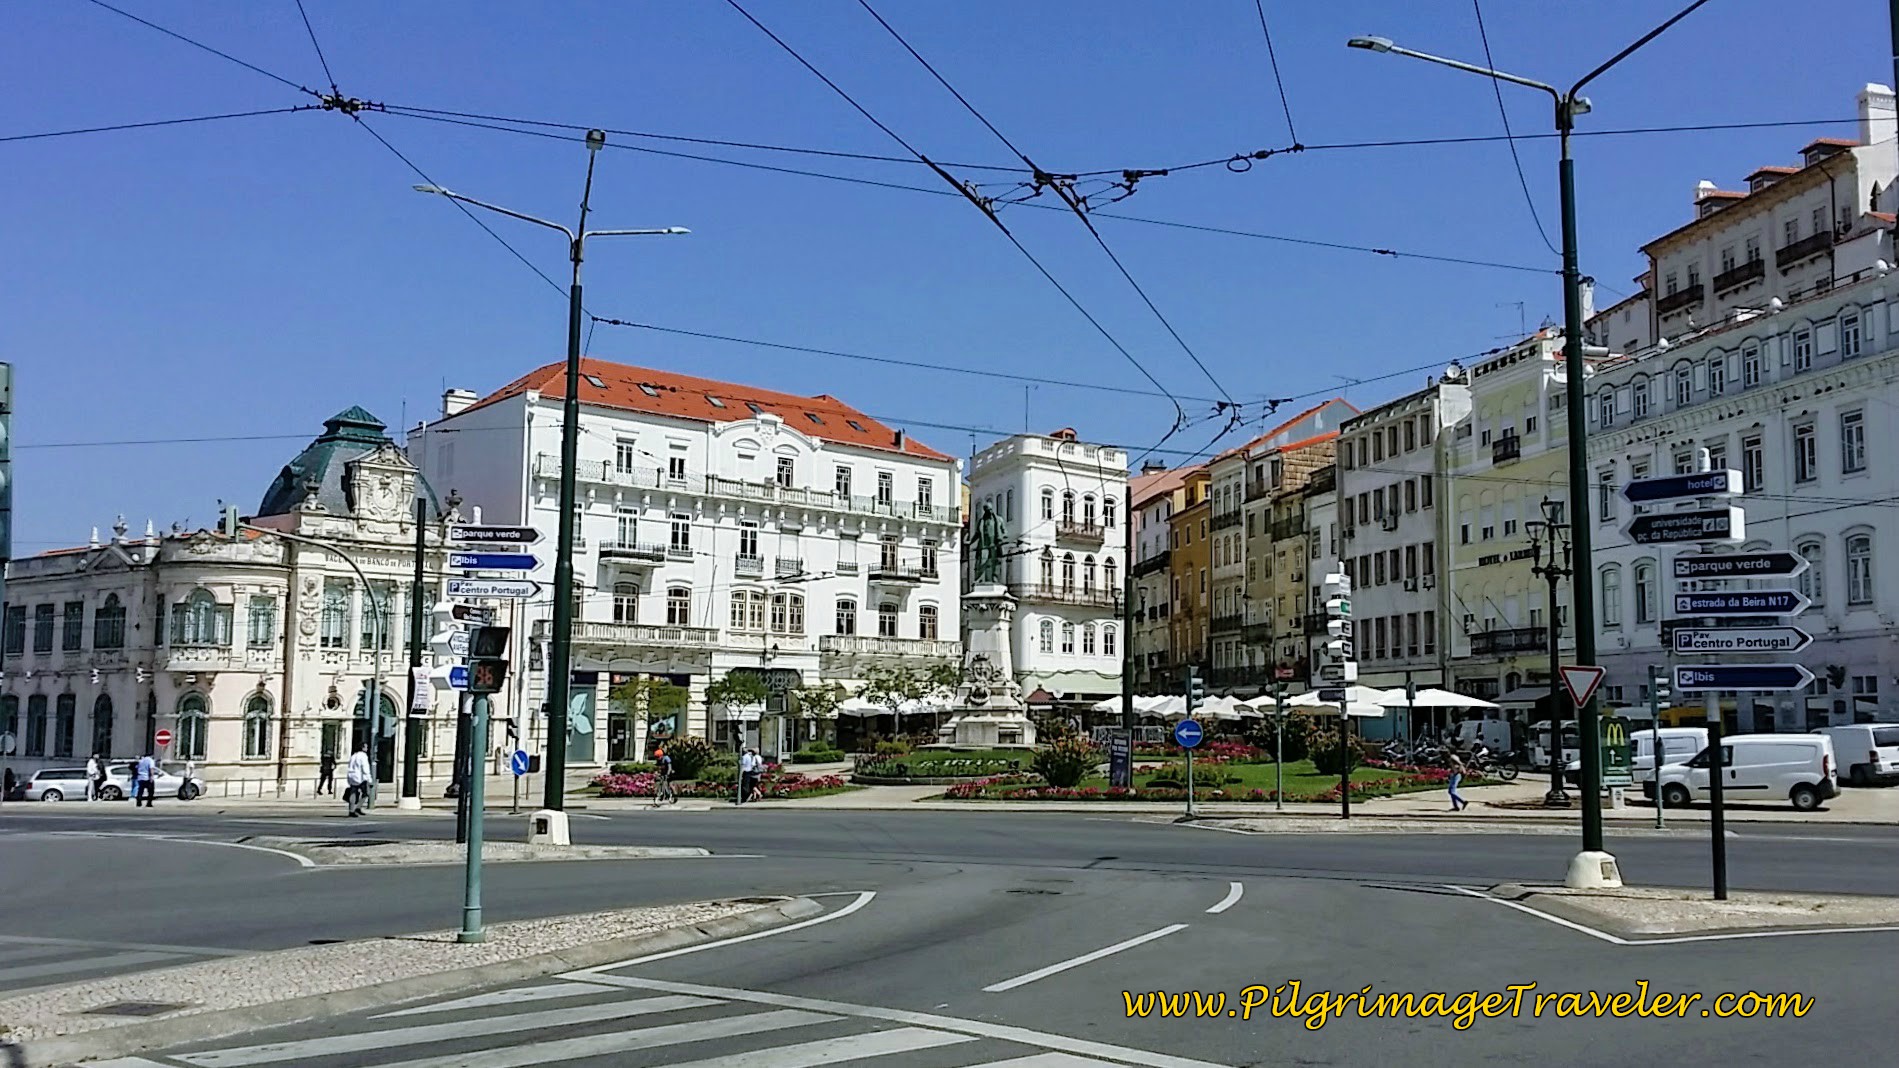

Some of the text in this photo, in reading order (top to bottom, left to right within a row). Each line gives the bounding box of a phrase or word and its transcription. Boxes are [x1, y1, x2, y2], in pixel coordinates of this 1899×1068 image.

[1687, 478, 1713, 489] hotel
[1651, 517, 1702, 528] universidade
[463, 530, 520, 539] parque verde
[1651, 531, 1661, 540] da
[1662, 528, 1702, 541] República
[461, 556, 478, 565] Ibis
[1690, 559, 1771, 573] parque verde
[461, 586, 529, 596] centro Portugal
[1692, 596, 1789, 607] estrada da Beira N17
[1693, 631, 1710, 639] Pav
[1693, 637, 1790, 649] centro Portugal
[1694, 671, 1715, 682] Ibis
